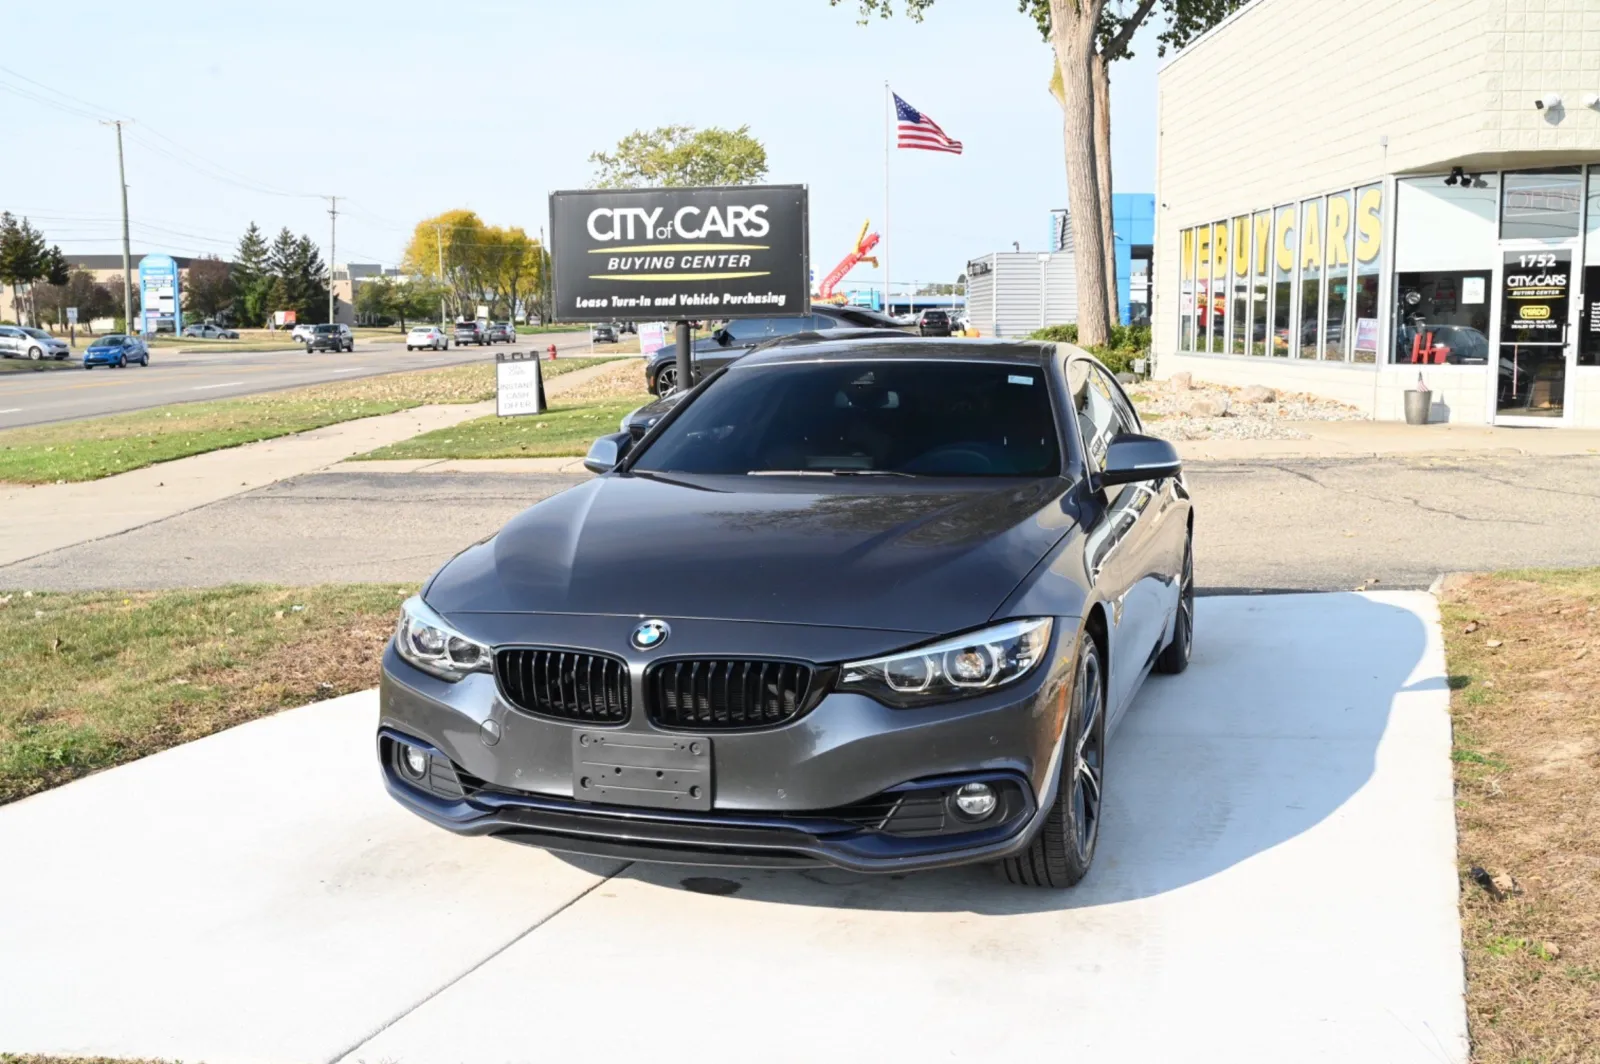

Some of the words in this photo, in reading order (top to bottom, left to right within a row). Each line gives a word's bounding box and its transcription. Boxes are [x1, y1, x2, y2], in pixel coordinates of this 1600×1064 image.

[586, 207, 664, 242] CITY
[656, 221, 674, 240] of
[674, 204, 770, 239] CARS
[1275, 188, 1382, 271] CARS
[608, 256, 675, 270] BUYING
[680, 254, 751, 269] CENTER
[1519, 254, 1556, 268] 1752
[1507, 275, 1532, 287] CITY
[1535, 274, 1567, 286] CARS
[576, 296, 608, 309] Lease
[654, 294, 676, 307] and
[680, 293, 719, 306] Vehicle
[723, 291, 786, 307] Purchasing
[506, 391, 529, 400] CASH
